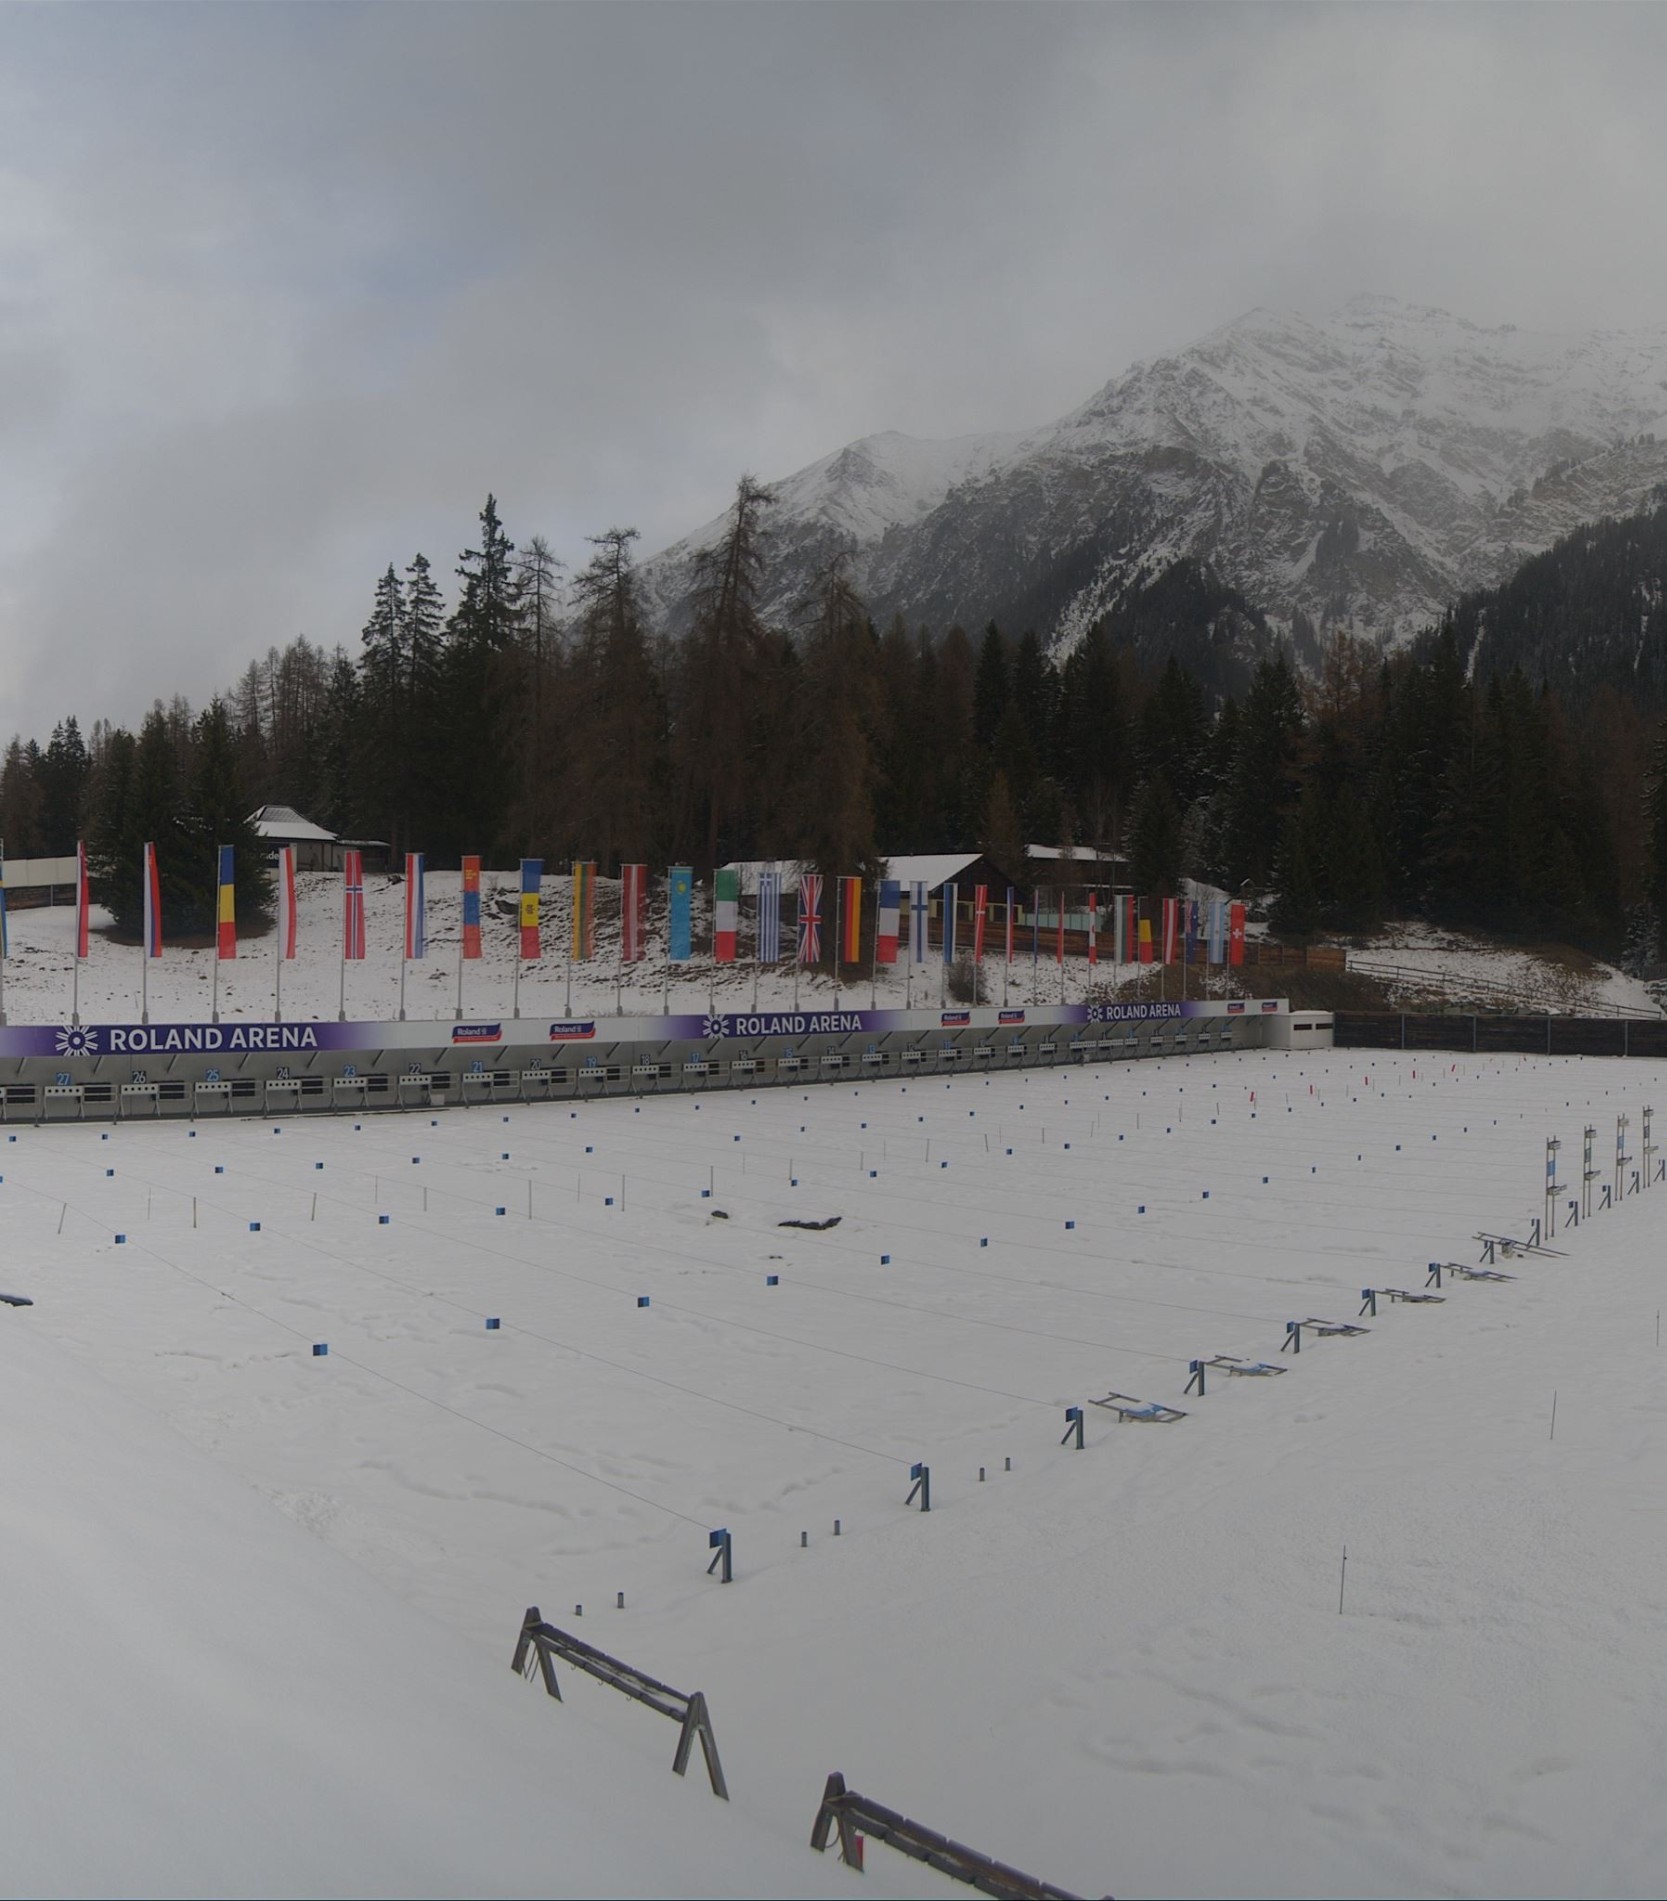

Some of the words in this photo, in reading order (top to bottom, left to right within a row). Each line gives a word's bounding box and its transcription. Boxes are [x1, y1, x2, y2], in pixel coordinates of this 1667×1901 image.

[1106, 1004, 1148, 1020] ROLAND
[1149, 1003, 1182, 1017] ARENA
[554, 1025, 576, 1033] Roland
[736, 1016, 805, 1036] ROLAND
[809, 1014, 862, 1033] ARENA
[457, 1027, 481, 1036] Roland
[109, 1027, 223, 1052] ROLAND
[229, 1026, 319, 1049] ARENA
[472, 1061, 484, 1073] 21
[530, 1059, 541, 1070] 20
[586, 1056, 597, 1068] 19
[206, 1068, 220, 1082] 25
[277, 1067, 290, 1080] 24
[344, 1065, 357, 1077] 23
[409, 1063, 421, 1075] 22
[57, 1072, 71, 1086] 27
[133, 1070, 147, 1084] 26
